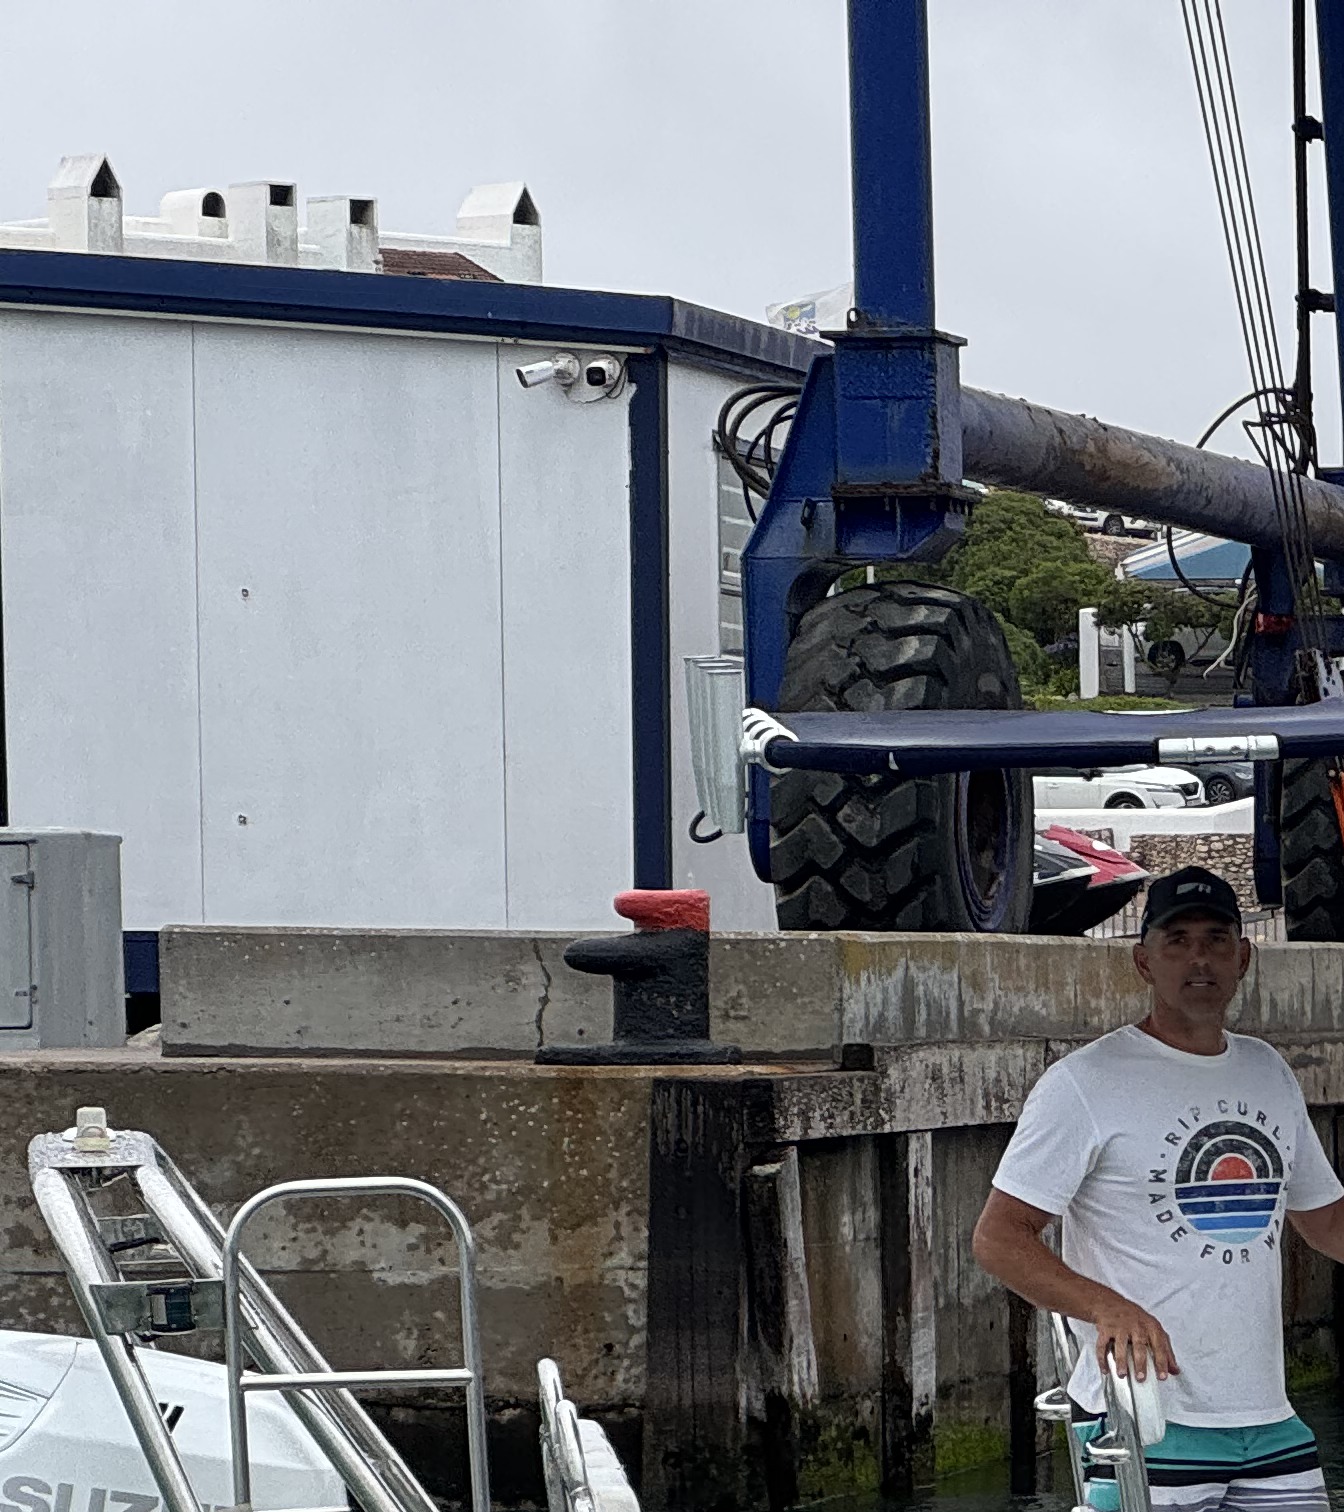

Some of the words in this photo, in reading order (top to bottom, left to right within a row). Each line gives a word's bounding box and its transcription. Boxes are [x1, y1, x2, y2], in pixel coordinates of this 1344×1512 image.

[1164, 1105, 1201, 1147] RIP
[1217, 1099, 1281, 1141] CURL
[1148, 1168, 1189, 1243] MADE
[1200, 1243, 1251, 1265] FOR
